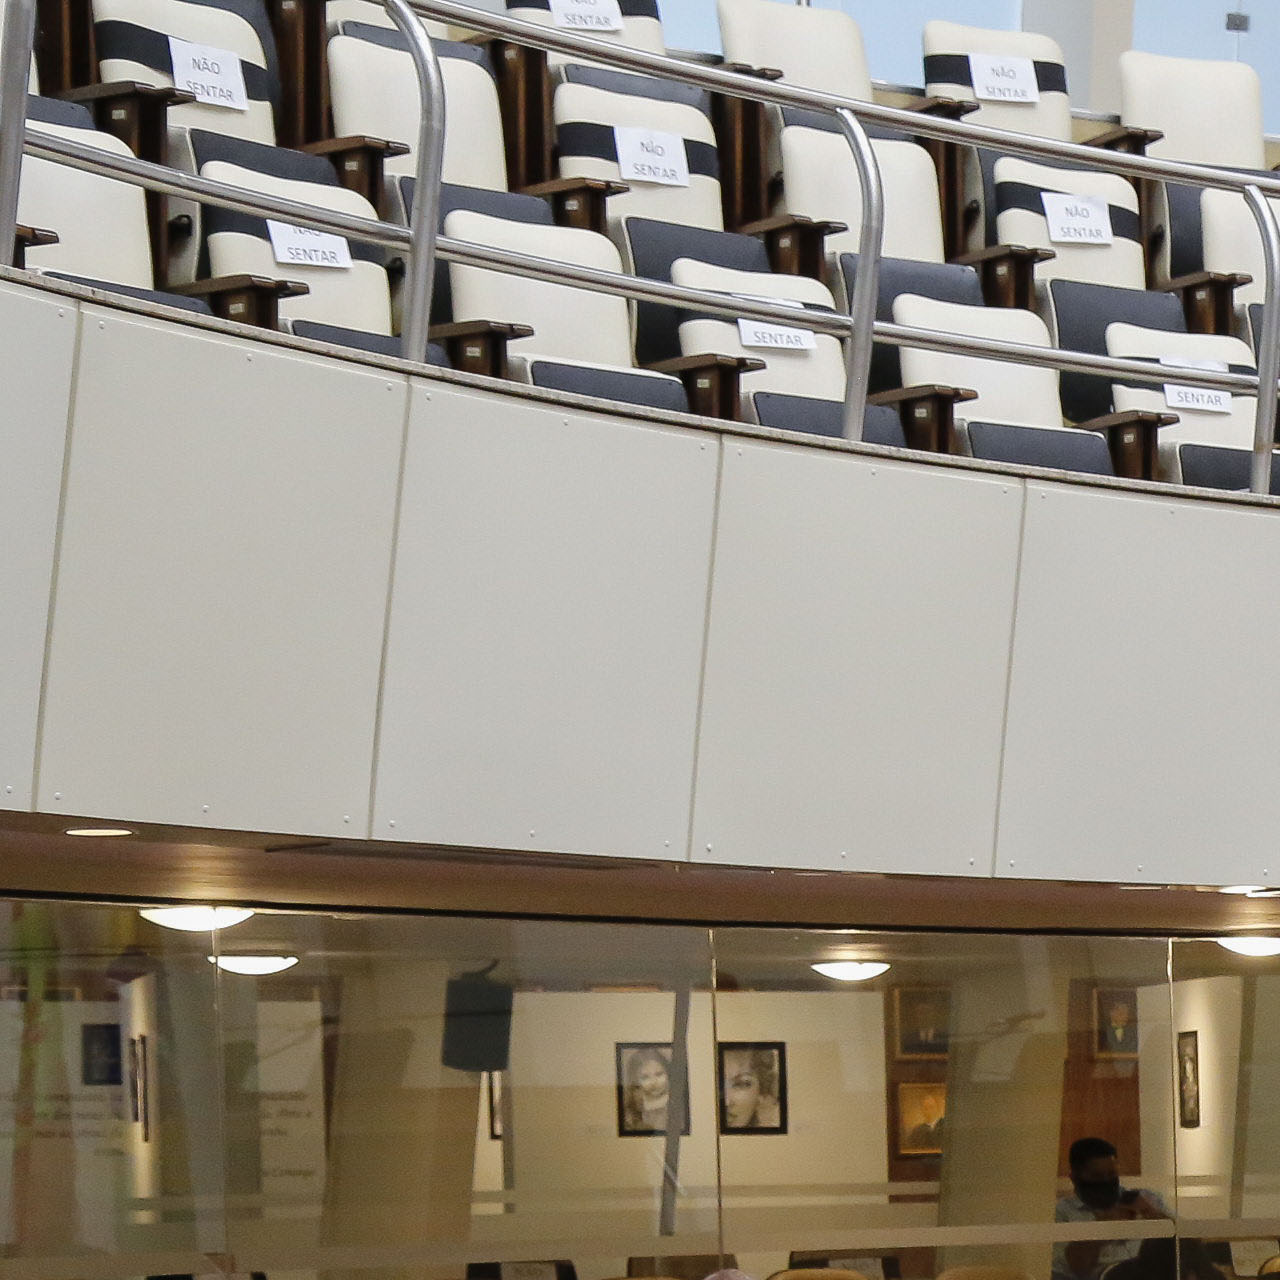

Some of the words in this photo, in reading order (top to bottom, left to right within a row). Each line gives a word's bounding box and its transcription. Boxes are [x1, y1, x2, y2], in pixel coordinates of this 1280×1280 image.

[191, 57, 221, 75] NÃO
[1065, 205, 1090, 218] NÃO
[1060, 227, 1103, 238] SENTAR
[287, 247, 340, 263] SENTAR
[753, 331, 804, 346] SENTAR
[1177, 391, 1223, 406] SENTAR
